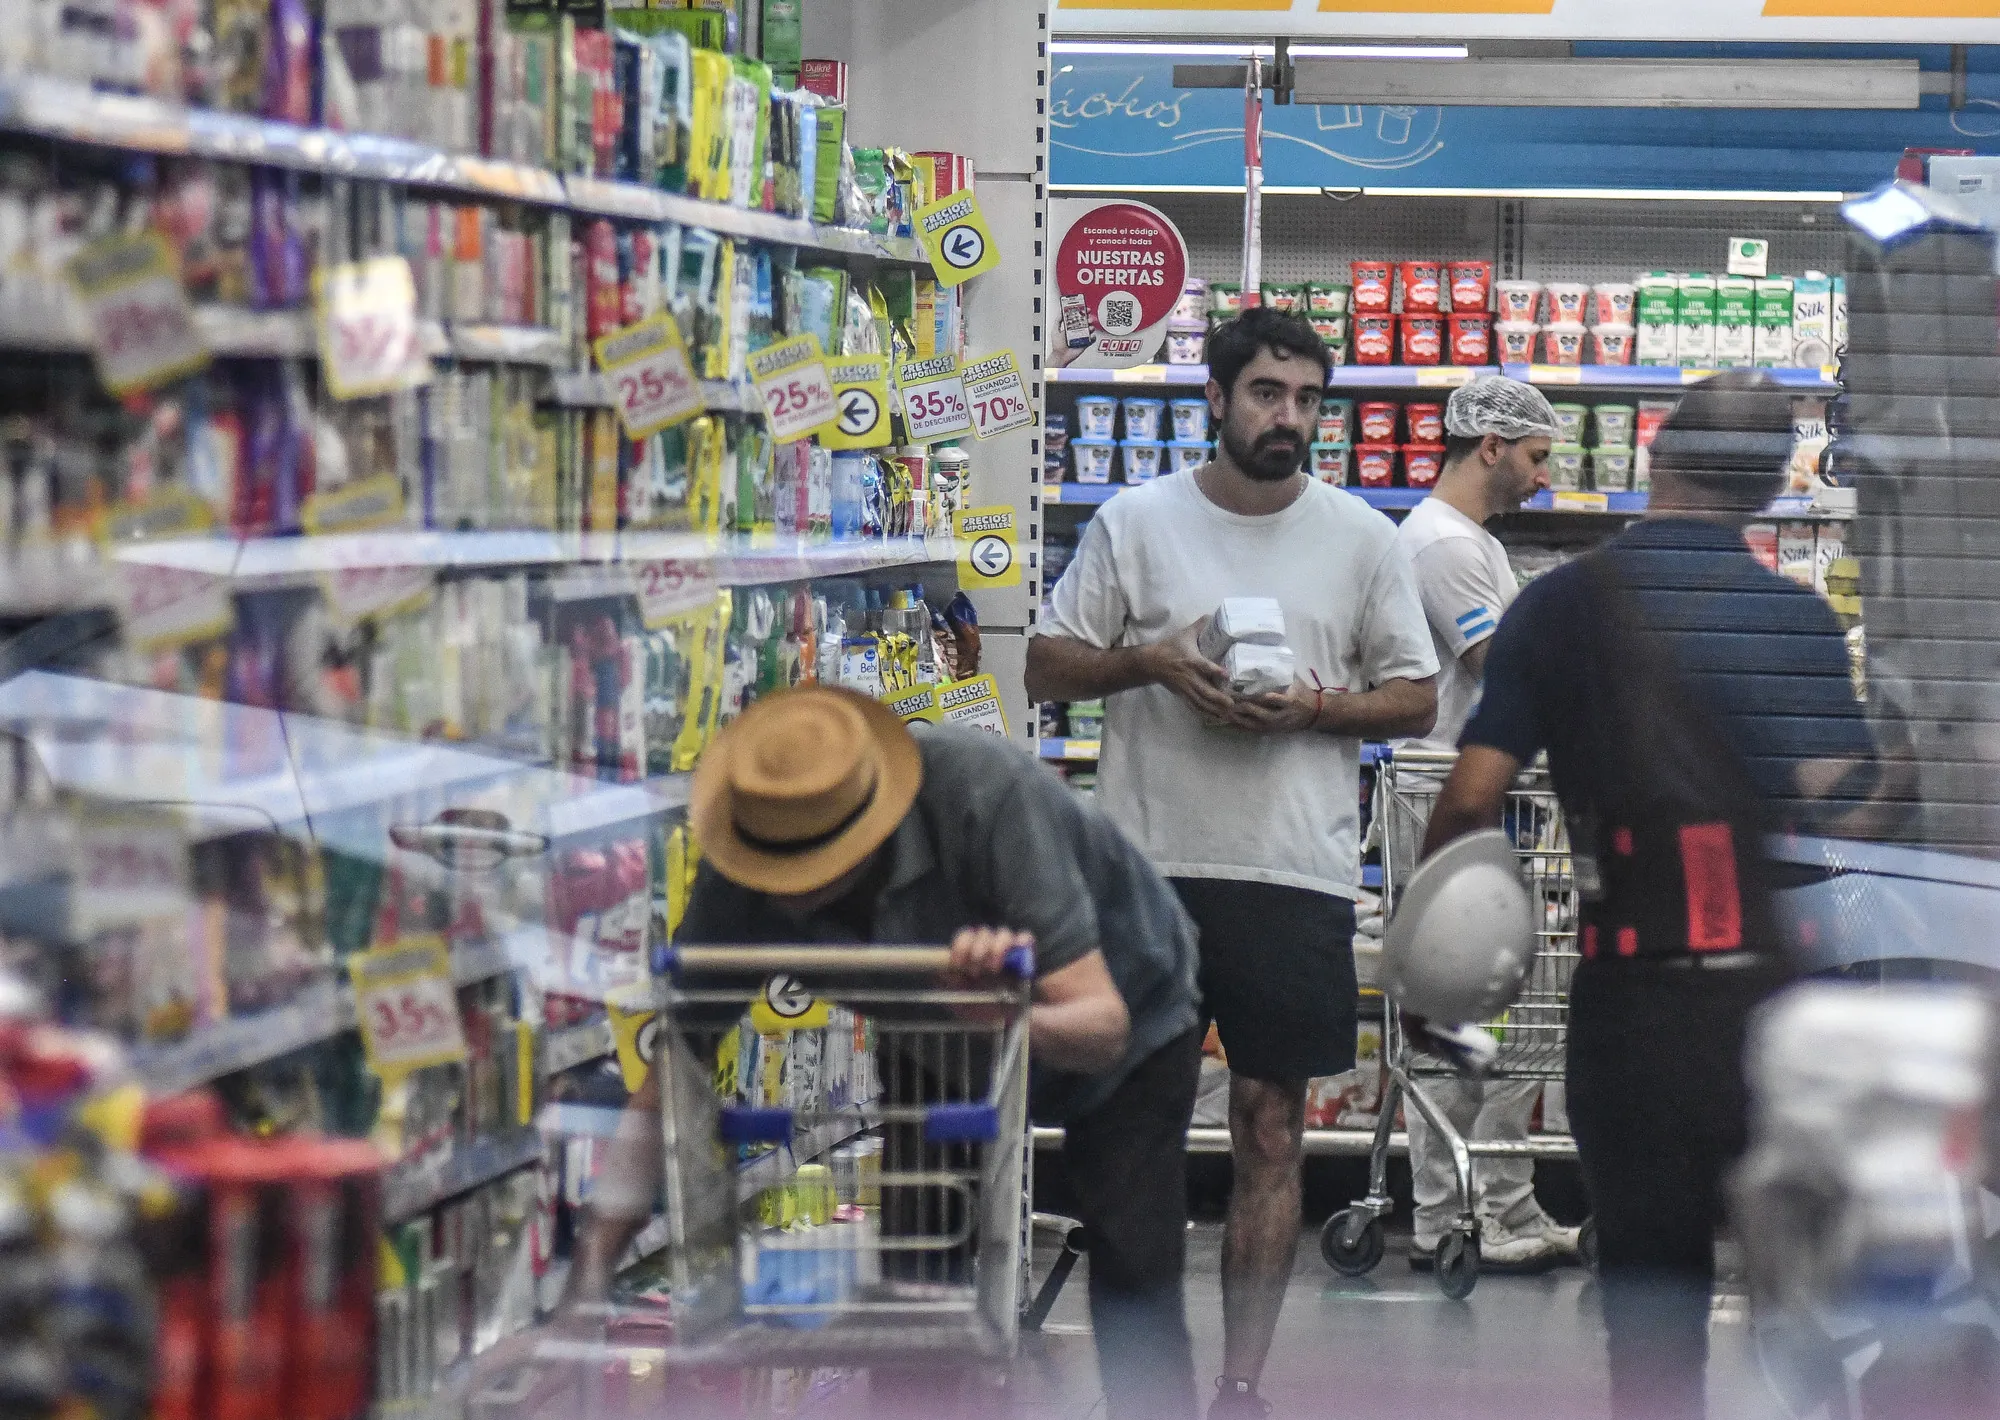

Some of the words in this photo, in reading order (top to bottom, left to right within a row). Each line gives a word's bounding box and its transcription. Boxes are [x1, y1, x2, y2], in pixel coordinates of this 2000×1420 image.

[1050, 66, 1192, 127] ácteos
[1083, 227, 1118, 235] Escaneá
[1129, 228, 1159, 236] código
[1096, 237, 1127, 245] conocé
[1129, 238, 1152, 246] todas
[1077, 250, 1165, 266] NUESTRAS
[1076, 268, 1164, 286] OFERTAS
[1795, 301, 1824, 321] Silk
[1099, 339, 1142, 352] COTO
[973, 377, 1011, 394] LLEVANDO
[1012, 374, 1018, 382] 2
[766, 380, 830, 418] 25%
[910, 390, 965, 420] 35%
[973, 396, 1024, 427] 70%
[913, 421, 923, 430] DE
[925, 413, 967, 428] DESCUENTO
[1796, 422, 1824, 443] Silk
[951, 703, 990, 720] LLEVANDO
[989, 701, 996, 709] 2
